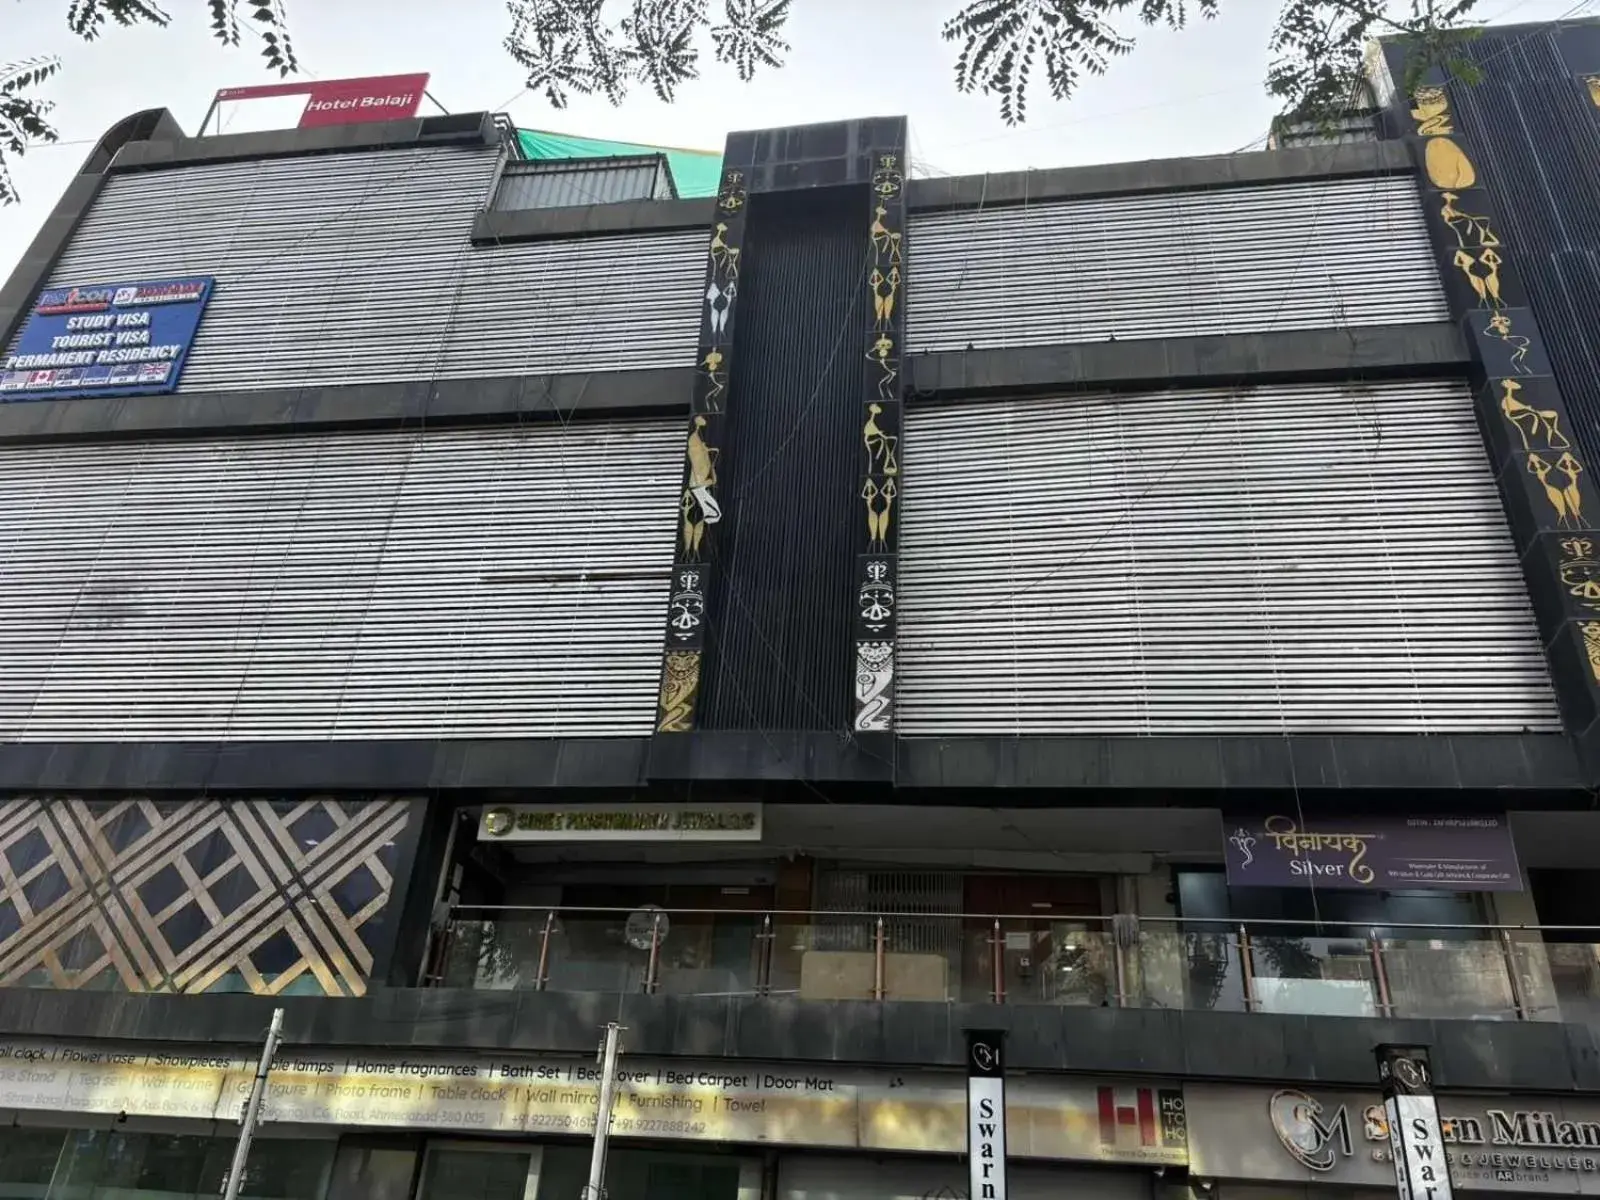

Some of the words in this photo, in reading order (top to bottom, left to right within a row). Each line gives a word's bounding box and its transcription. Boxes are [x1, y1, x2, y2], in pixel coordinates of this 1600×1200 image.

[306, 98, 357, 112] Hotel
[360, 94, 413, 110] Balaji
[67, 315, 112, 330] STUDY
[115, 312, 150, 326] VISA
[52, 334, 114, 349] TOURIST
[115, 330, 150, 344] VISA
[5, 351, 97, 369] PERMANENT
[97, 345, 181, 364] RESIDENCY
[1290, 859, 1344, 877] Silver
[15, 1048, 46, 1062] clock
[61, 1050, 103, 1064] Flower
[106, 1053, 136, 1065] vase
[155, 1054, 231, 1069] Showpieces
[292, 1059, 334, 1075] lamps
[355, 1060, 396, 1075] Home
[500, 1064, 533, 1078] Bath
[537, 1066, 561, 1080] Set
[613, 1070, 650, 1083] over
[666, 1070, 694, 1085] Bed
[697, 1072, 748, 1090] Carpet
[764, 1075, 802, 1090] Door
[805, 1077, 834, 1092] Mat
[141, 1076, 171, 1090] Wall
[172, 1077, 214, 1091] frame
[325, 1084, 365, 1098] Photo
[368, 1084, 411, 1098] frame
[431, 1086, 468, 1100] Table
[470, 1087, 507, 1101] clock
[527, 1088, 558, 1103] Wall
[560, 1090, 600, 1105] mirro
[628, 1094, 703, 1111] Furnishing
[724, 1098, 766, 1112] Towel
[1363, 1104, 1485, 1145] Srn
[1486, 1108, 1600, 1150] Milan
[1479, 1152, 1600, 1172] JEWELLER
[1496, 1170, 1515, 1182] AR
[1516, 1170, 1549, 1183] brand
